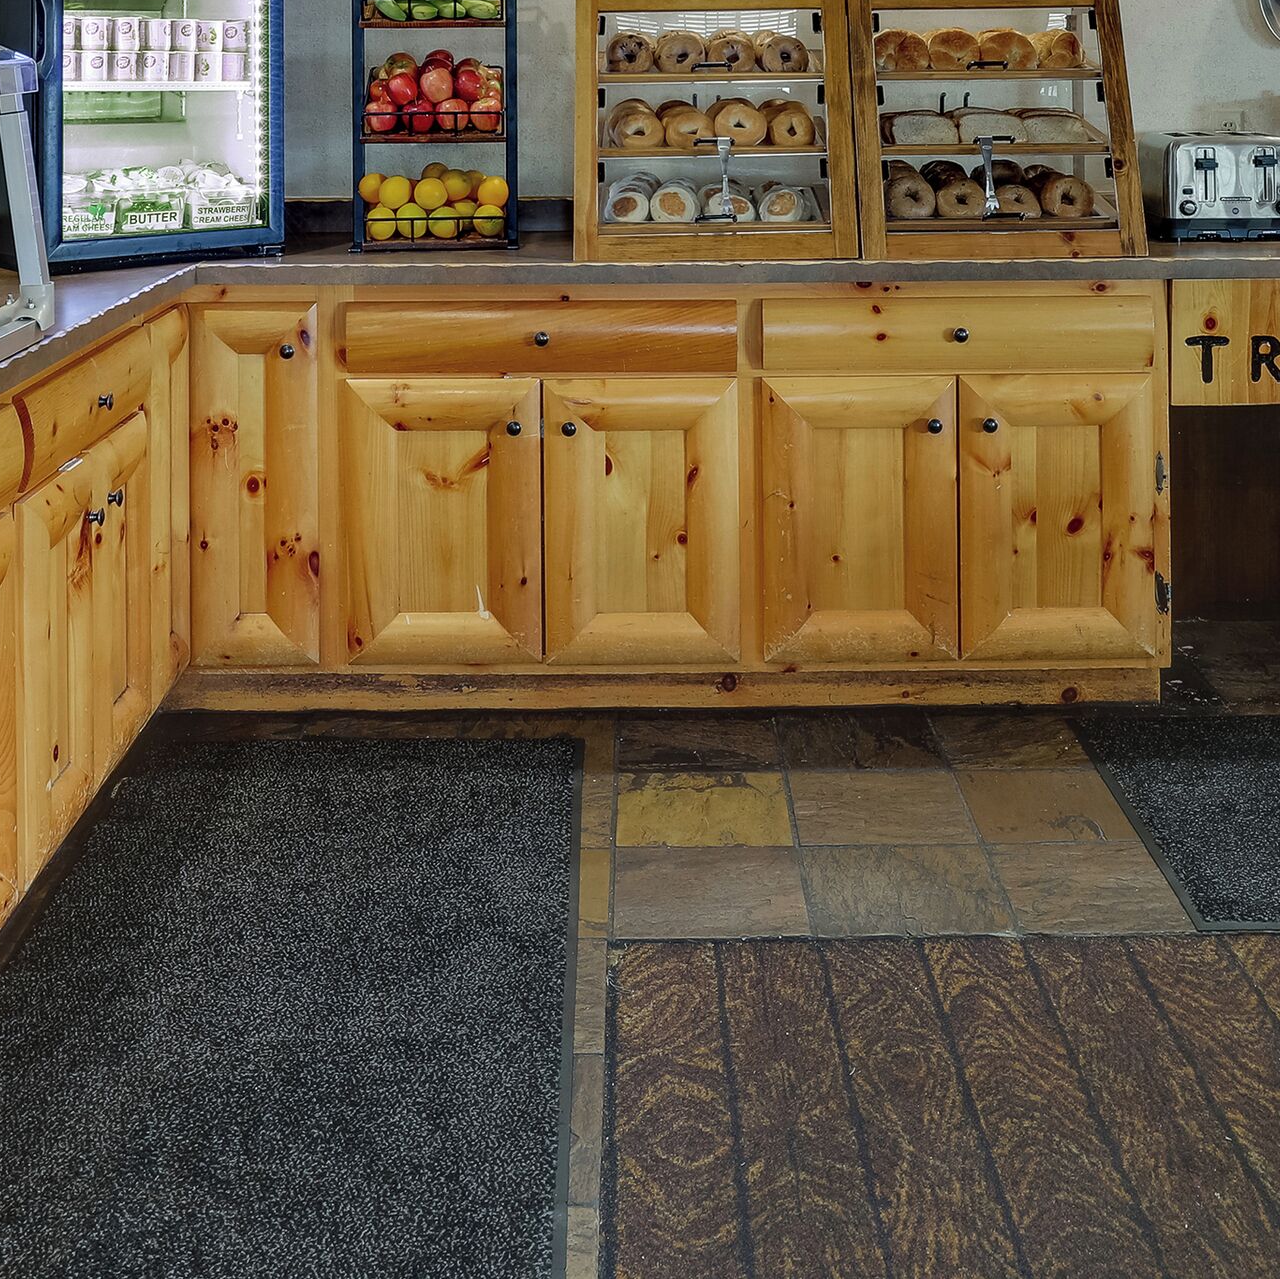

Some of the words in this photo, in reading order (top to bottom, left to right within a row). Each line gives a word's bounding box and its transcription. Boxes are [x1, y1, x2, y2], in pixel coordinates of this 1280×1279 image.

[129, 212, 177, 224] BUTTER
[193, 216, 222, 224] CREAM
[223, 214, 248, 223] CHEES
